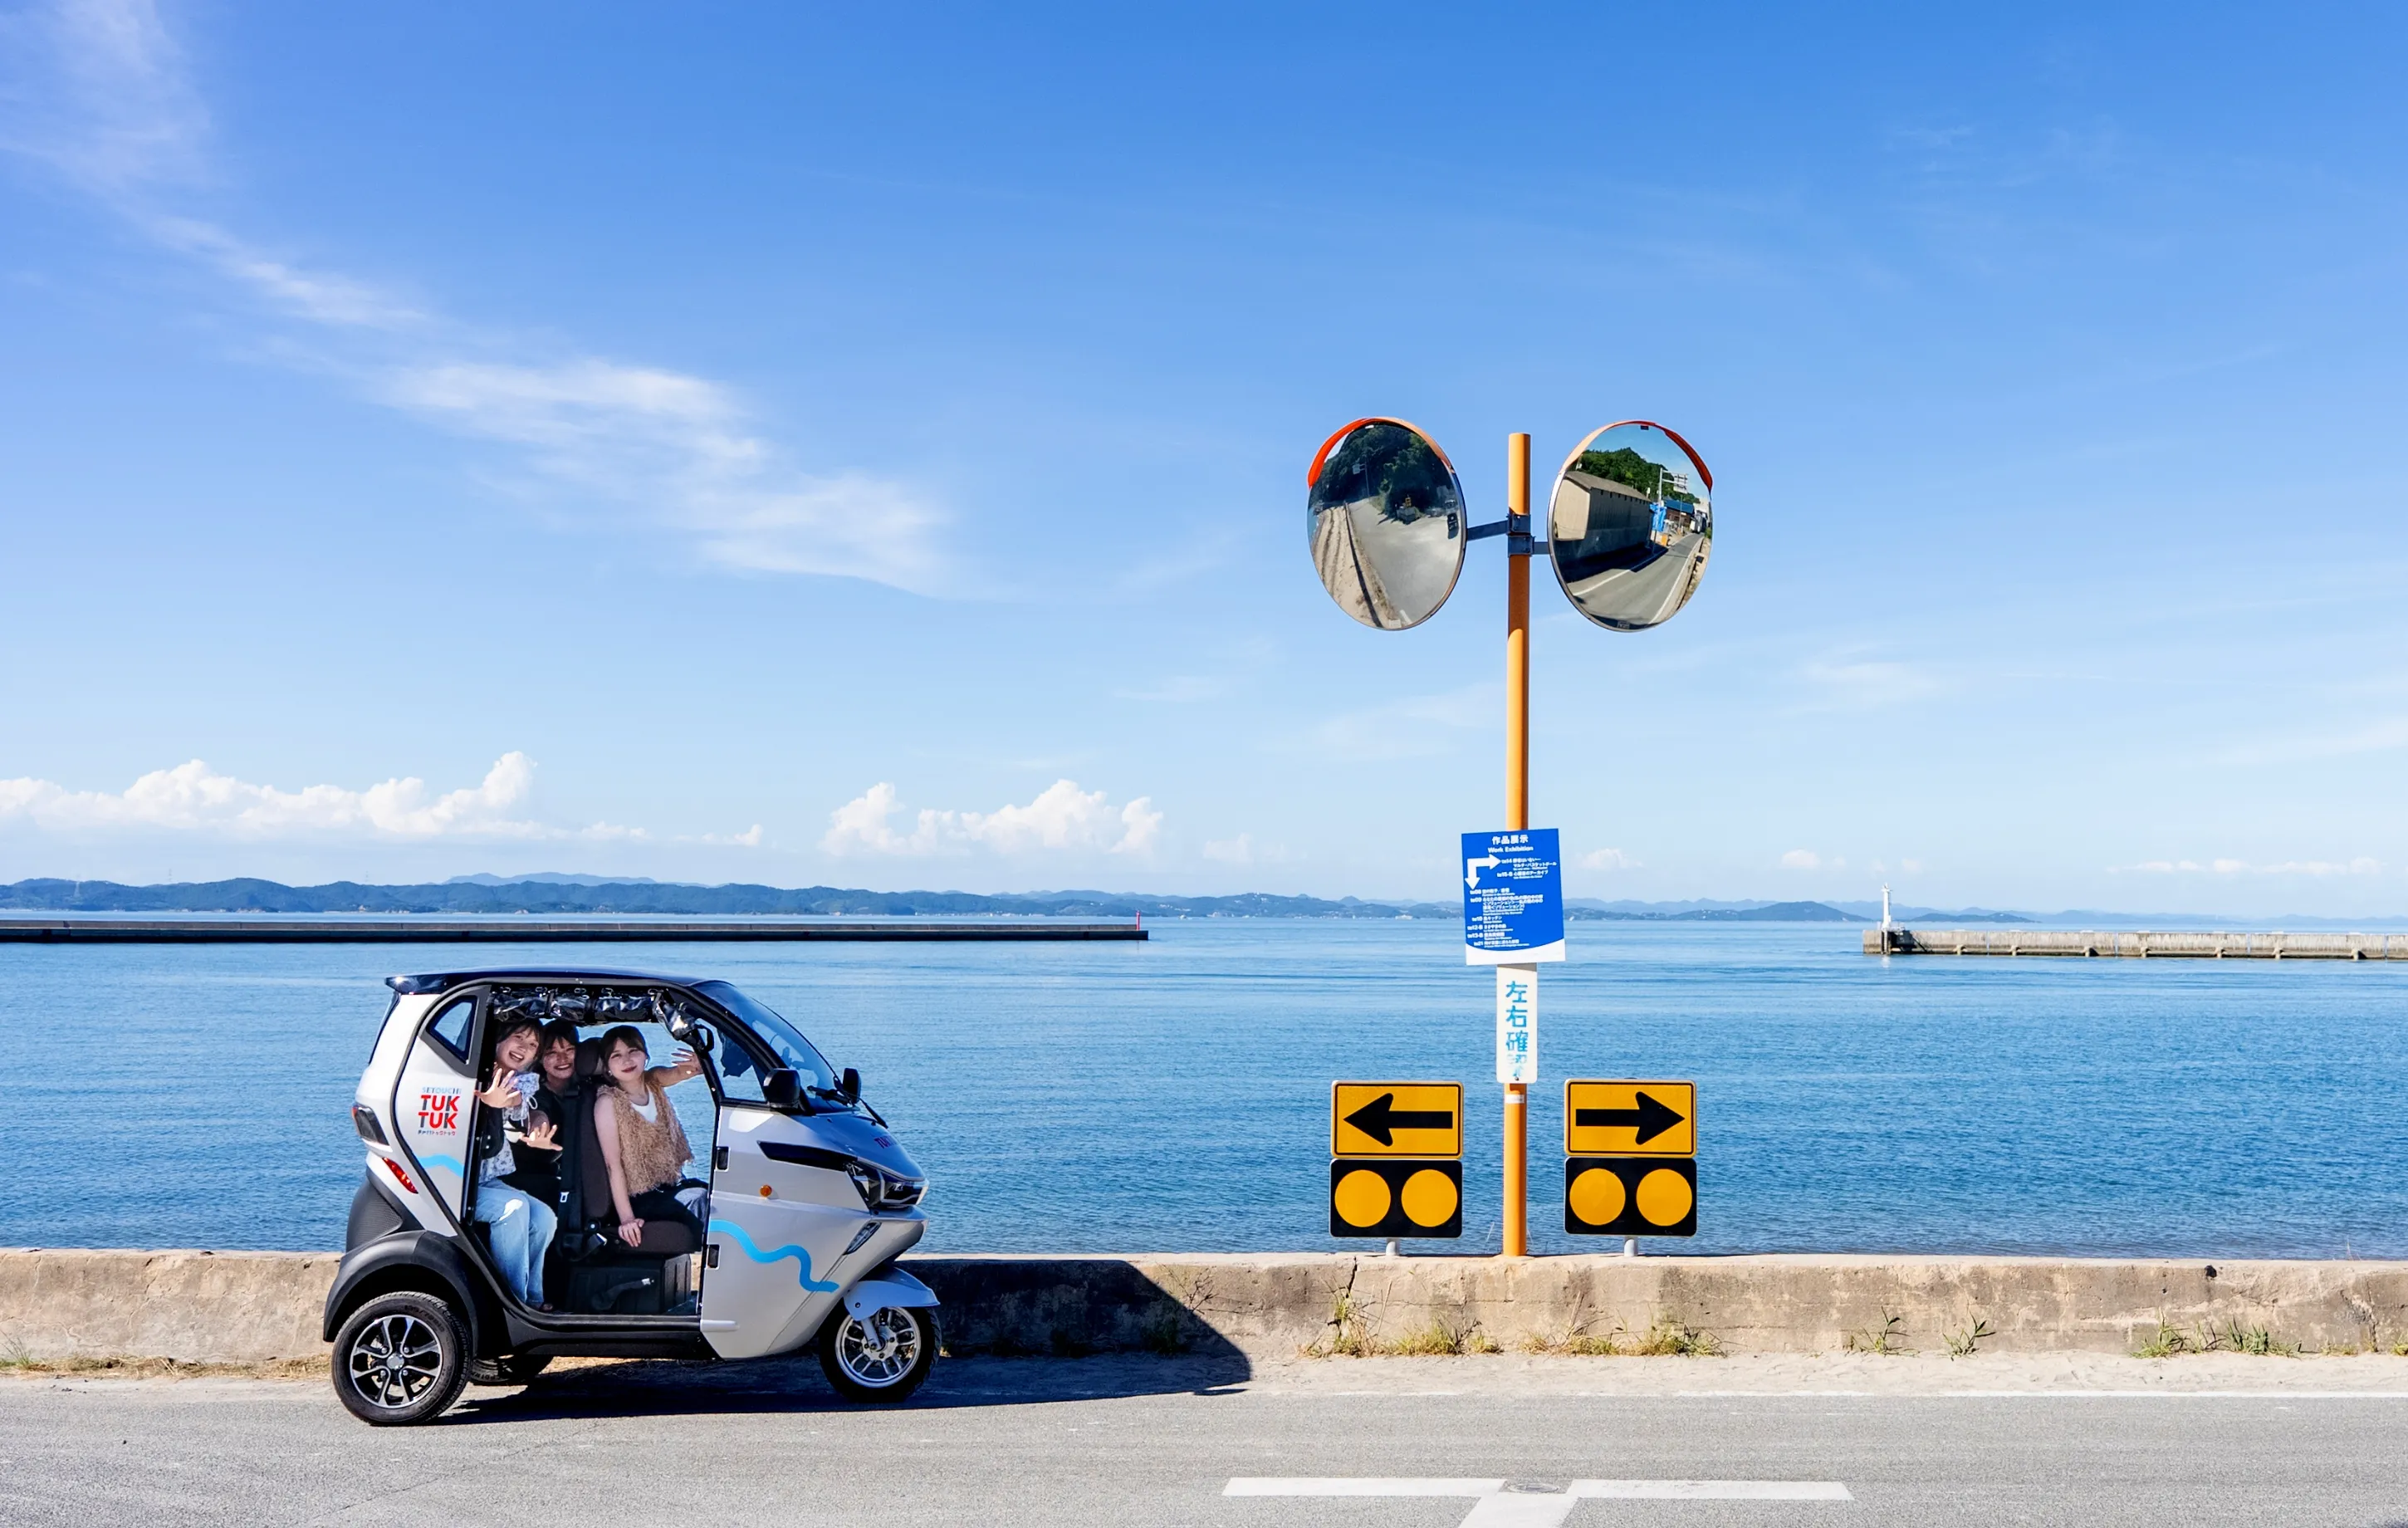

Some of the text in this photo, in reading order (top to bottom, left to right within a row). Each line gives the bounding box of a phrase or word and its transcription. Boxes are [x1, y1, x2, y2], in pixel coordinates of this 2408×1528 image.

[1492, 835, 1529, 845] 作品展示
[421, 1095, 460, 1111] TUK
[418, 1112, 458, 1129] TUK
